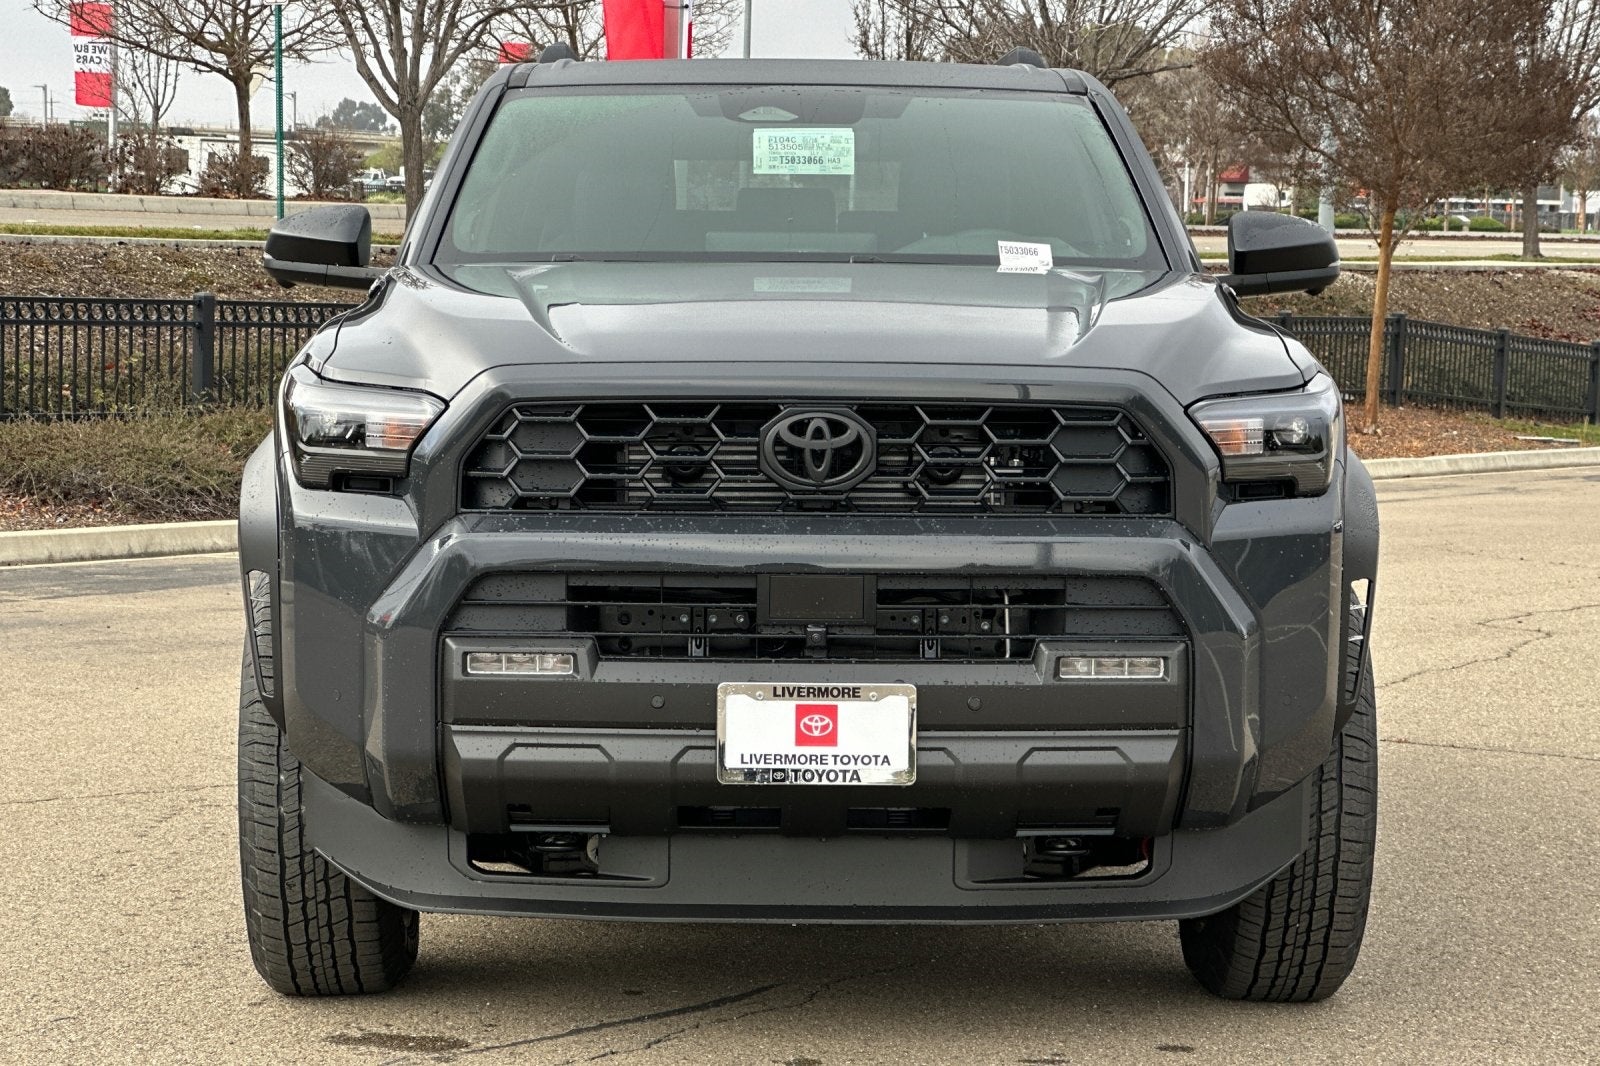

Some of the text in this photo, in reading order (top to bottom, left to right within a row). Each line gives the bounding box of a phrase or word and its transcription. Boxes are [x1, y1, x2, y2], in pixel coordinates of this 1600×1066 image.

[779, 156, 824, 164] T5033066
[1000, 246, 1039, 256] T5033066
[772, 686, 861, 698] LIVERMORE
[740, 754, 891, 766] LIVERMORE TOYOTA
[791, 769, 861, 782] TOYOTA
